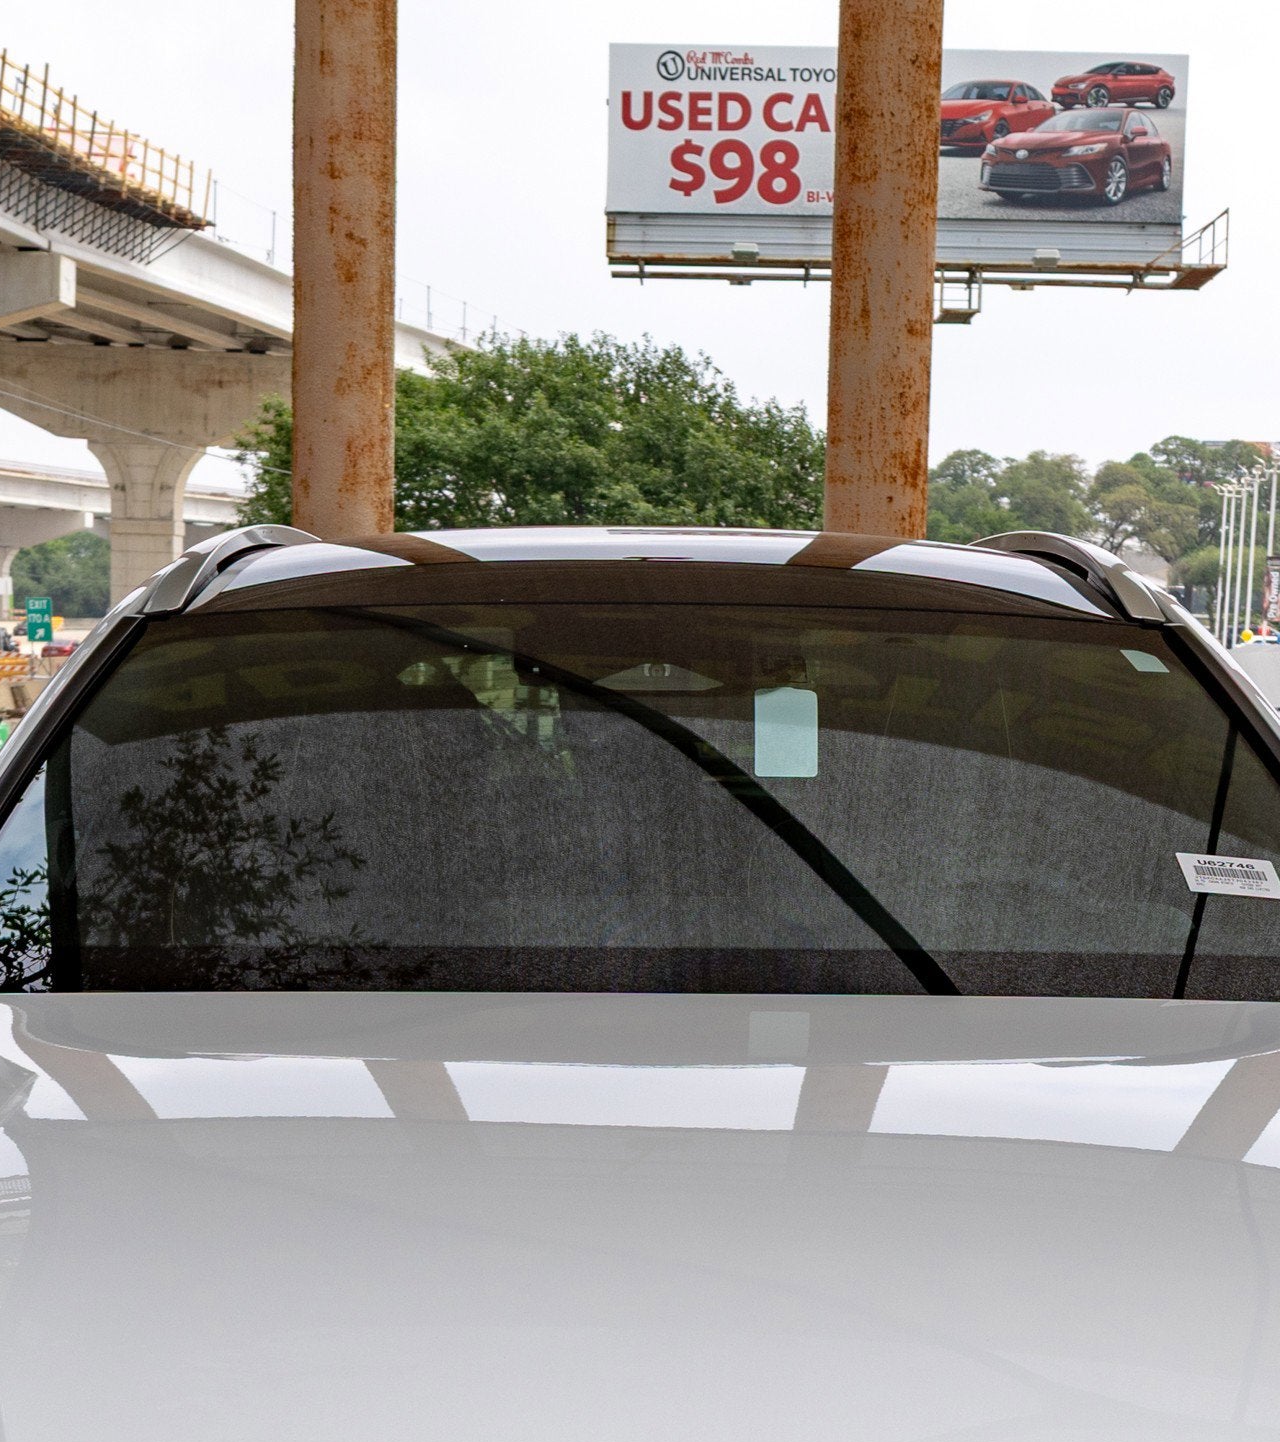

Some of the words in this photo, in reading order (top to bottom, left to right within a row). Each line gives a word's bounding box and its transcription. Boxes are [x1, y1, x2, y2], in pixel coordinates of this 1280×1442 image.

[686, 50, 707, 69] Red
[708, 51, 754, 65] McCombs
[687, 67, 786, 81] UNIVERSAL
[790, 68, 836, 82] TOYO
[621, 91, 752, 131] USED
[762, 92, 837, 132] CA
[669, 139, 801, 204] $98
[28, 599, 48, 610] EXIT
